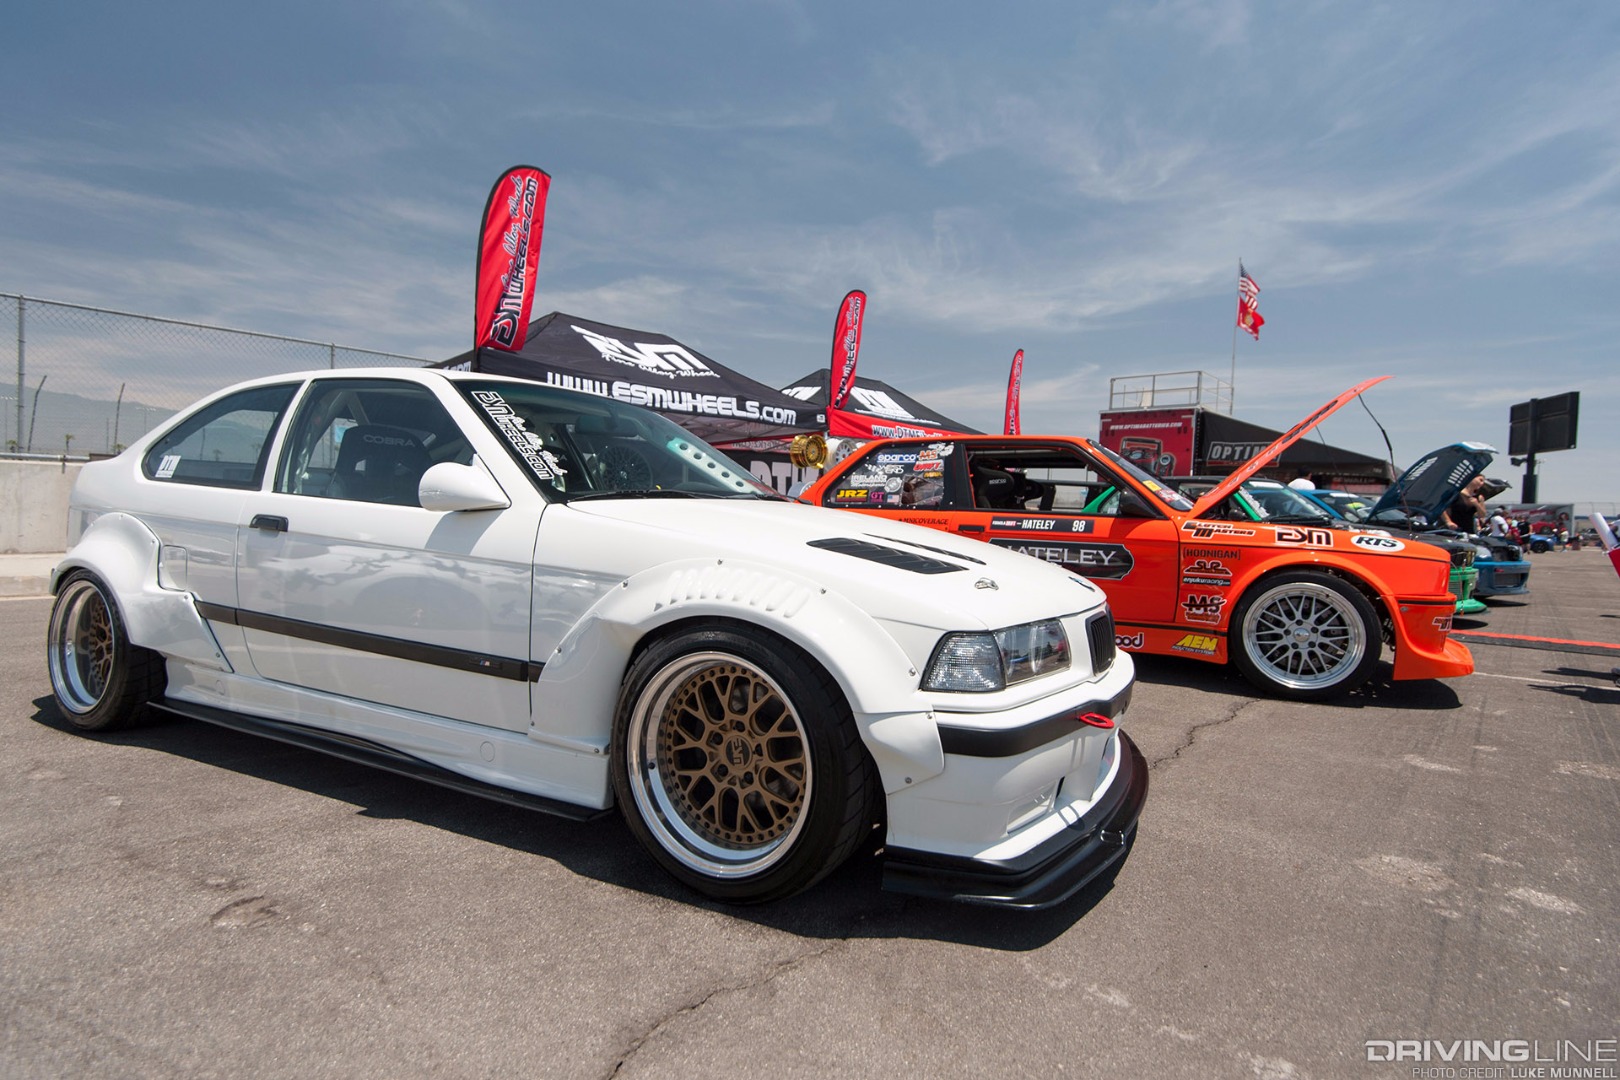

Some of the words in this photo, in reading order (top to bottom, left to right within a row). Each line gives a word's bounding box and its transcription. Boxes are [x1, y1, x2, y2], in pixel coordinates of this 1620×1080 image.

[363, 434, 416, 447] COBRA
[837, 489, 868, 498] JRZ
[870, 492, 884, 500] GT
[1022, 519, 1056, 530] HATELEY
[1072, 520, 1086, 532] 98
[1355, 536, 1399, 548] RTS
[1175, 634, 1219, 651] AEM
